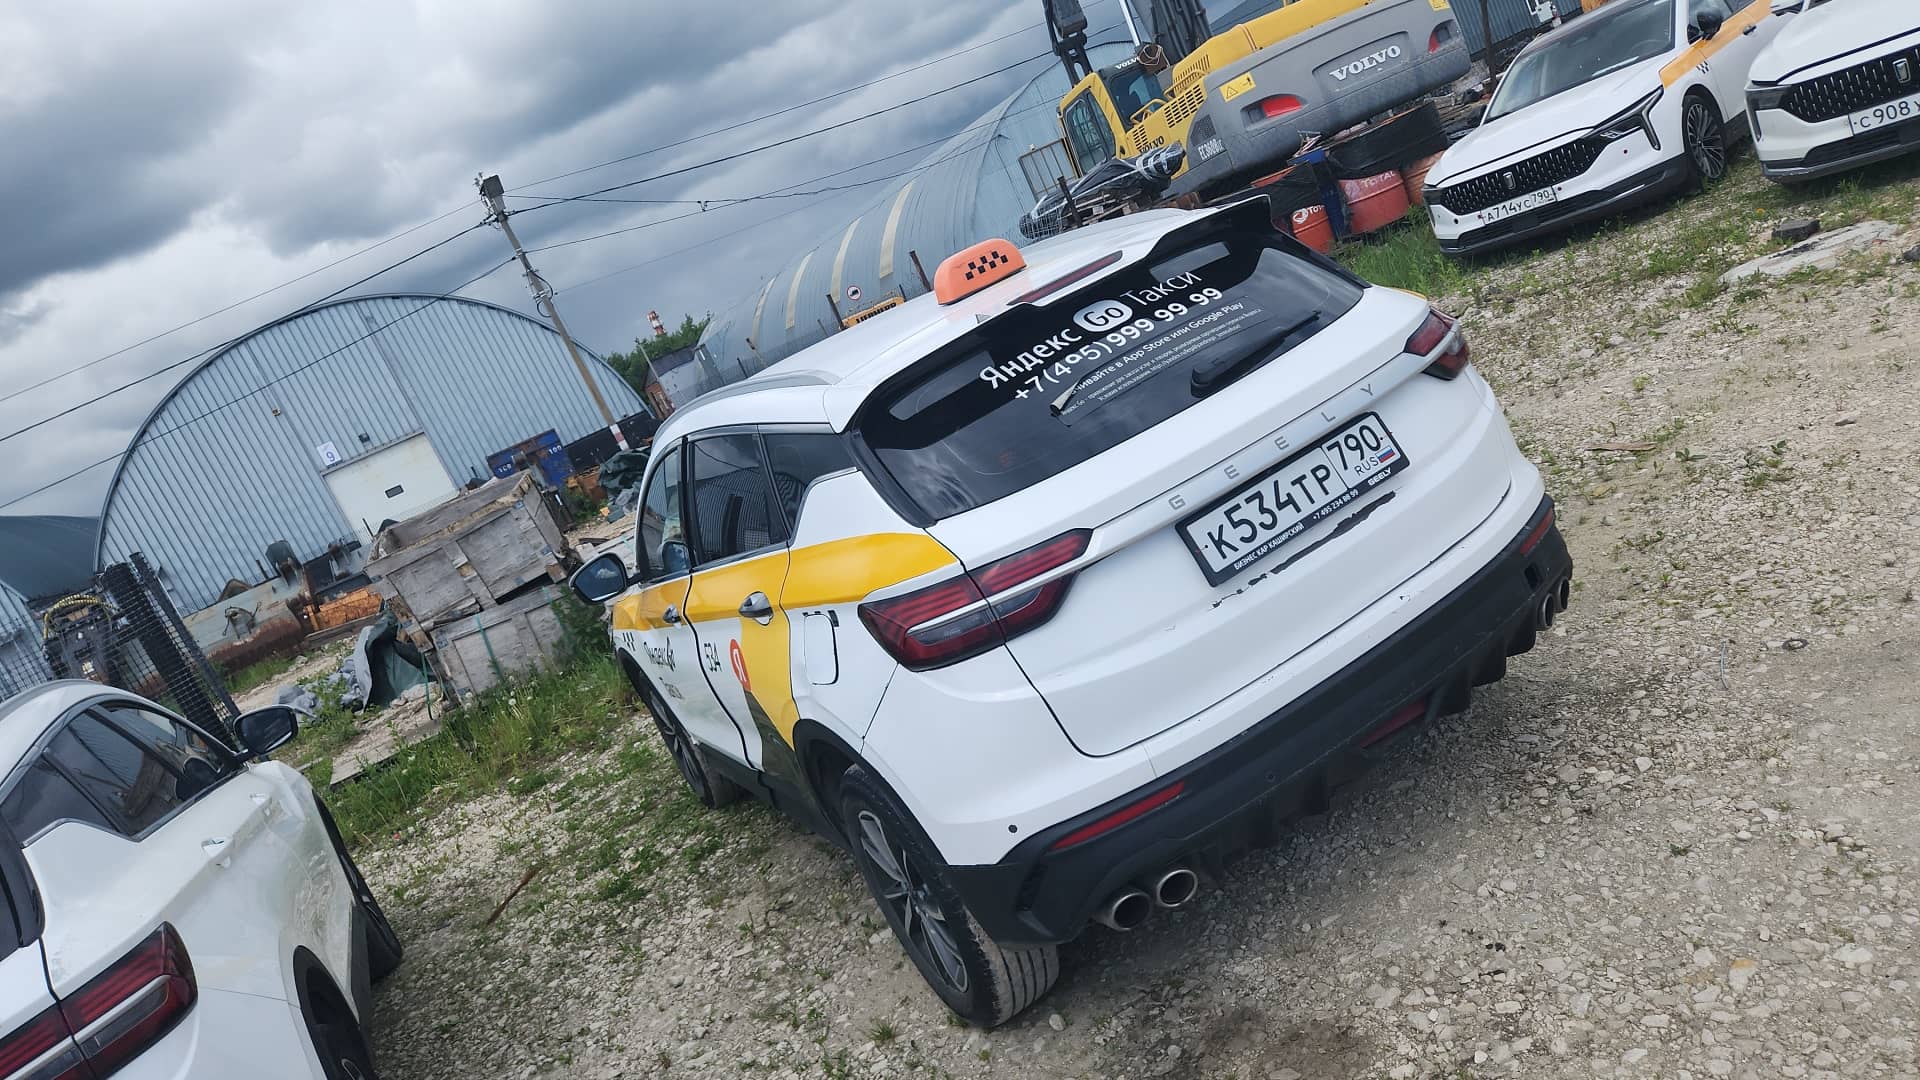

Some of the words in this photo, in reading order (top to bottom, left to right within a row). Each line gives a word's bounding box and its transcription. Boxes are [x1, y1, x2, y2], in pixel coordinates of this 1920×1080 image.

[1115, 56, 1140, 70] VOLV
[1329, 45, 1401, 81] VOLVO
[1307, 204, 1326, 215] TOT
[1487, 199, 1532, 221] А714УС
[1531, 190, 1550, 203] 790
[1154, 303, 1189, 322] 99
[1189, 288, 1223, 306] 99
[979, 328, 1083, 390] Яндекс
[1120, 271, 1203, 306] Такси
[1122, 350, 1145, 364] App
[1143, 336, 1172, 352] Store
[1170, 326, 1191, 339] или
[1188, 311, 1224, 329] Google
[1221, 302, 1244, 313] Play
[1168, 383, 1375, 511] GEELY
[1354, 456, 1379, 477] RUS
[1367, 466, 1393, 487] GEELY
[1207, 463, 1331, 559] К534ТР
[1327, 424, 1382, 471] 790
[1233, 552, 1258, 570] БИЗНЕС
[1257, 544, 1269, 557] КАР
[1268, 522, 1305, 550] КАШИРСКИЙ
